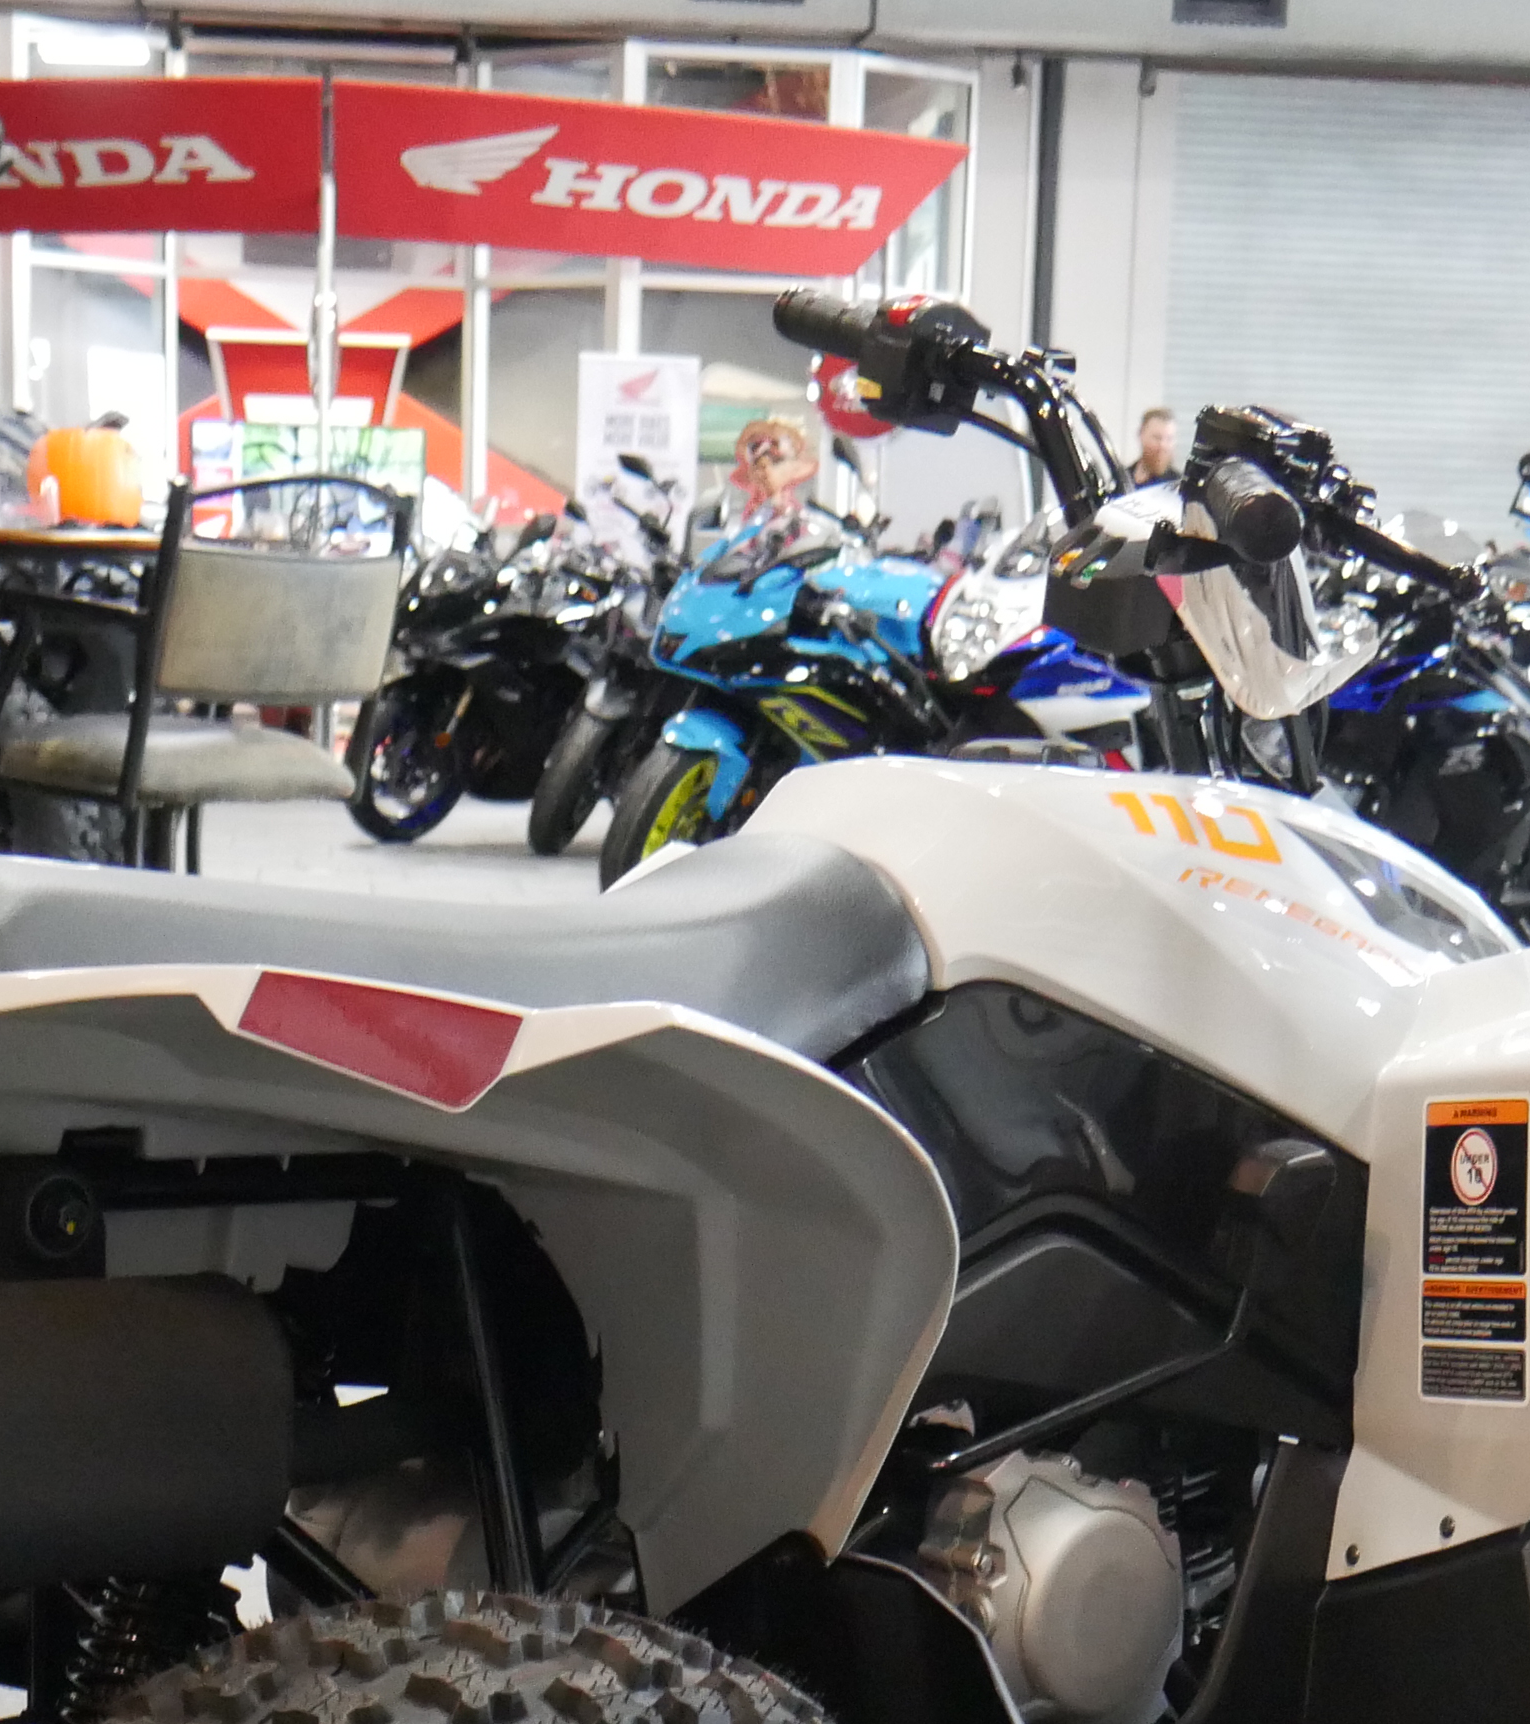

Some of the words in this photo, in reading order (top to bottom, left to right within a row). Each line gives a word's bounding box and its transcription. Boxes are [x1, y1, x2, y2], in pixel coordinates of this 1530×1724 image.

[530, 156, 883, 230] HONDA
[1109, 791, 1282, 864] 110
[1178, 866, 1412, 974] RENEGA
[1459, 1153, 1491, 1165] UNDER
